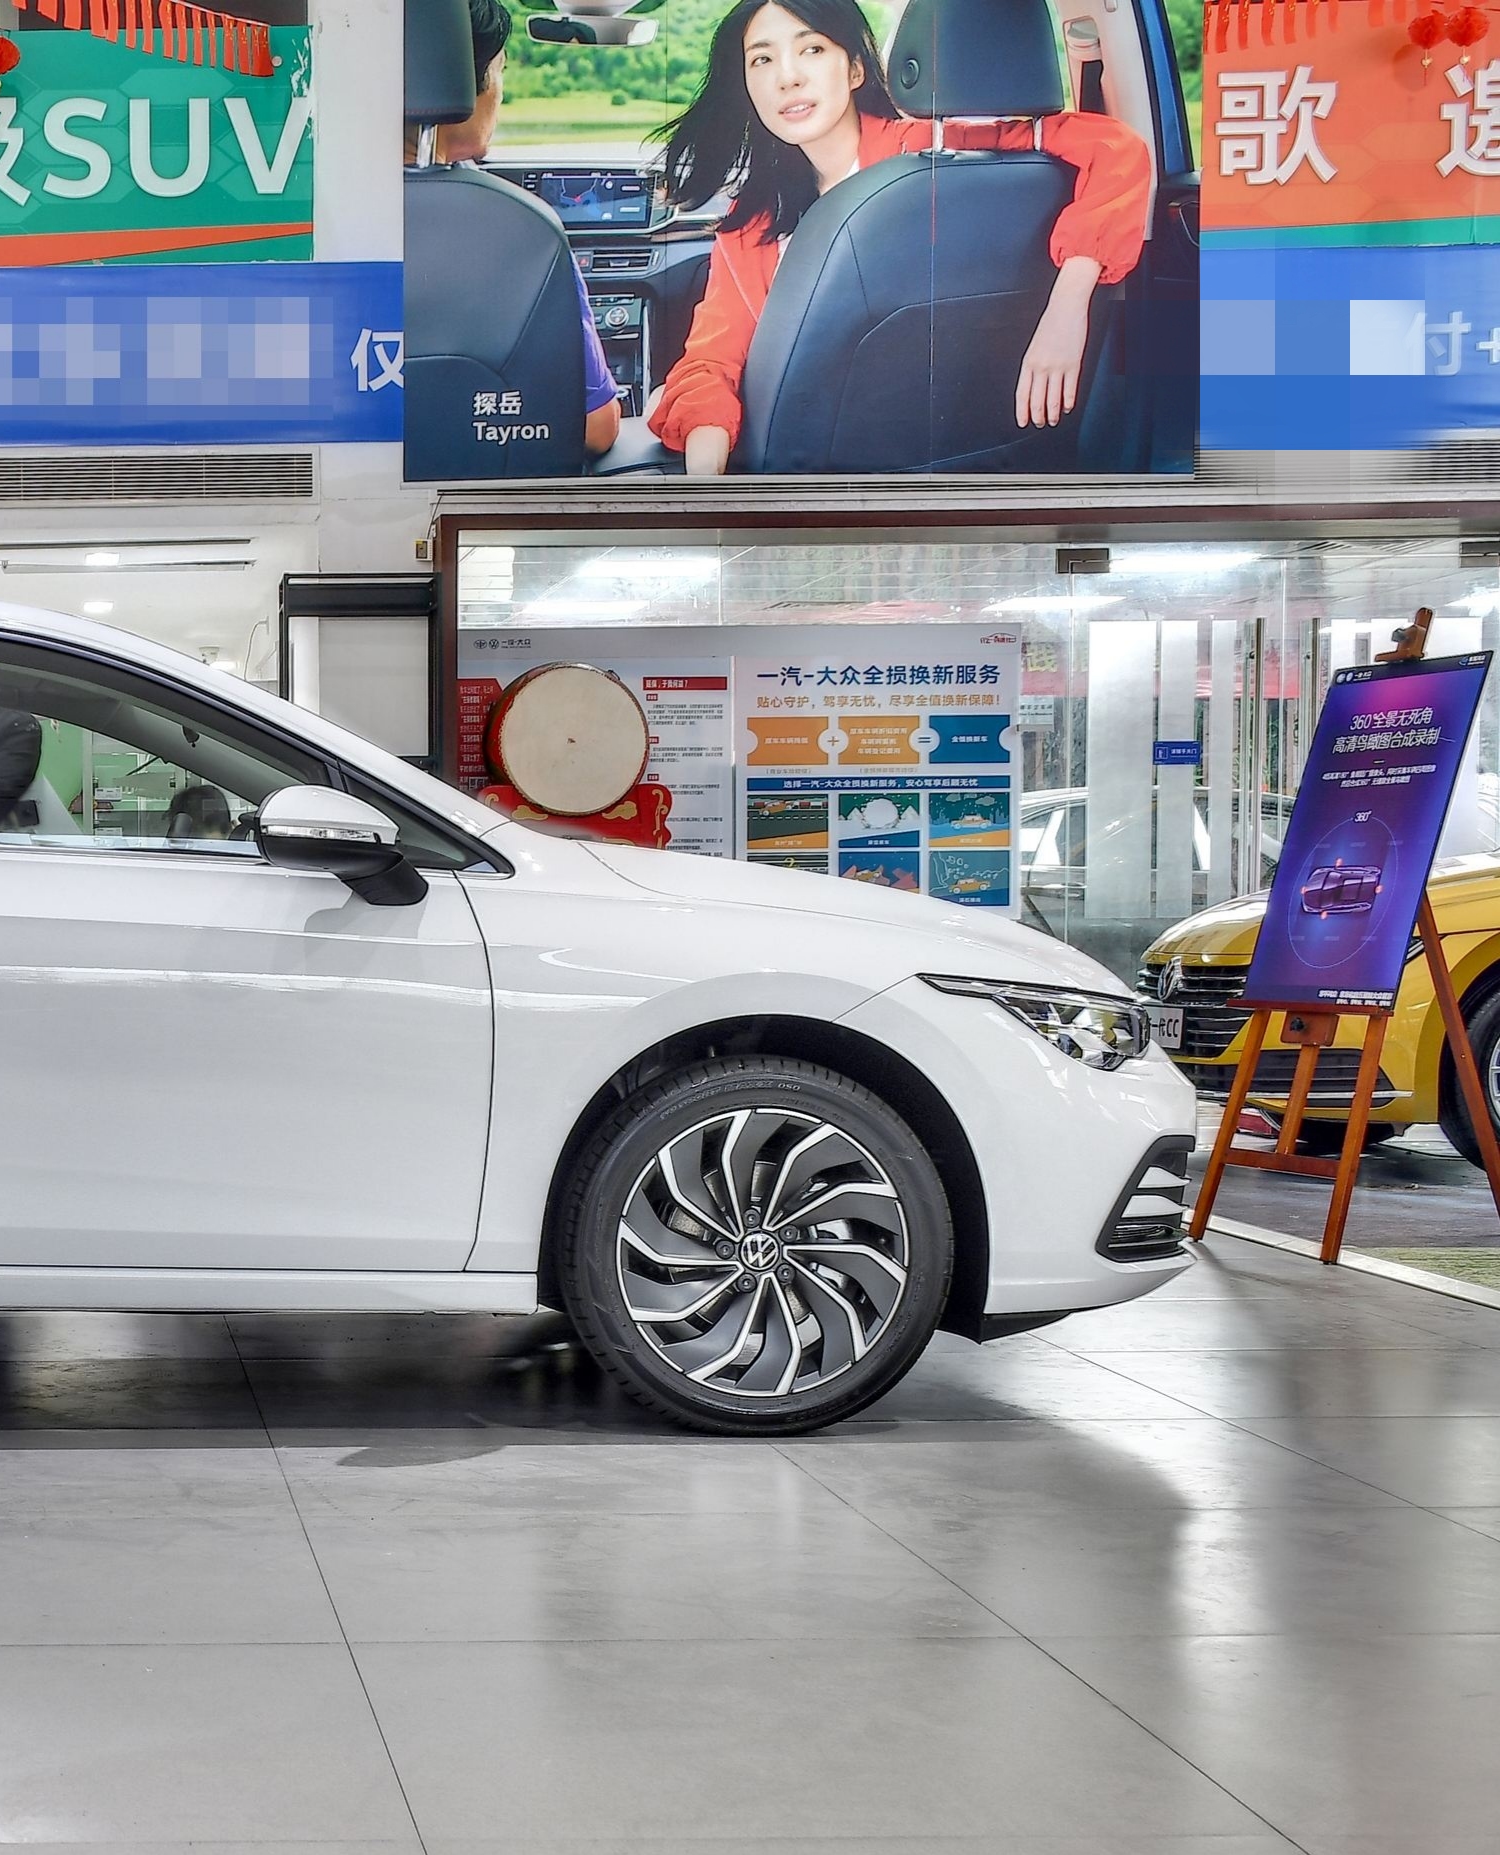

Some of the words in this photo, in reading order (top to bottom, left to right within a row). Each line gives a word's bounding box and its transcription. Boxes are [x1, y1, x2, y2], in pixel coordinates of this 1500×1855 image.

[1215, 63, 1338, 186] 歌
[473, 390, 522, 416] 探岳
[472, 421, 550, 446] Tayron
[756, 664, 1001, 687] 一汽-大众全损换新服务
[1149, 1016, 1180, 1039] 一代CC
